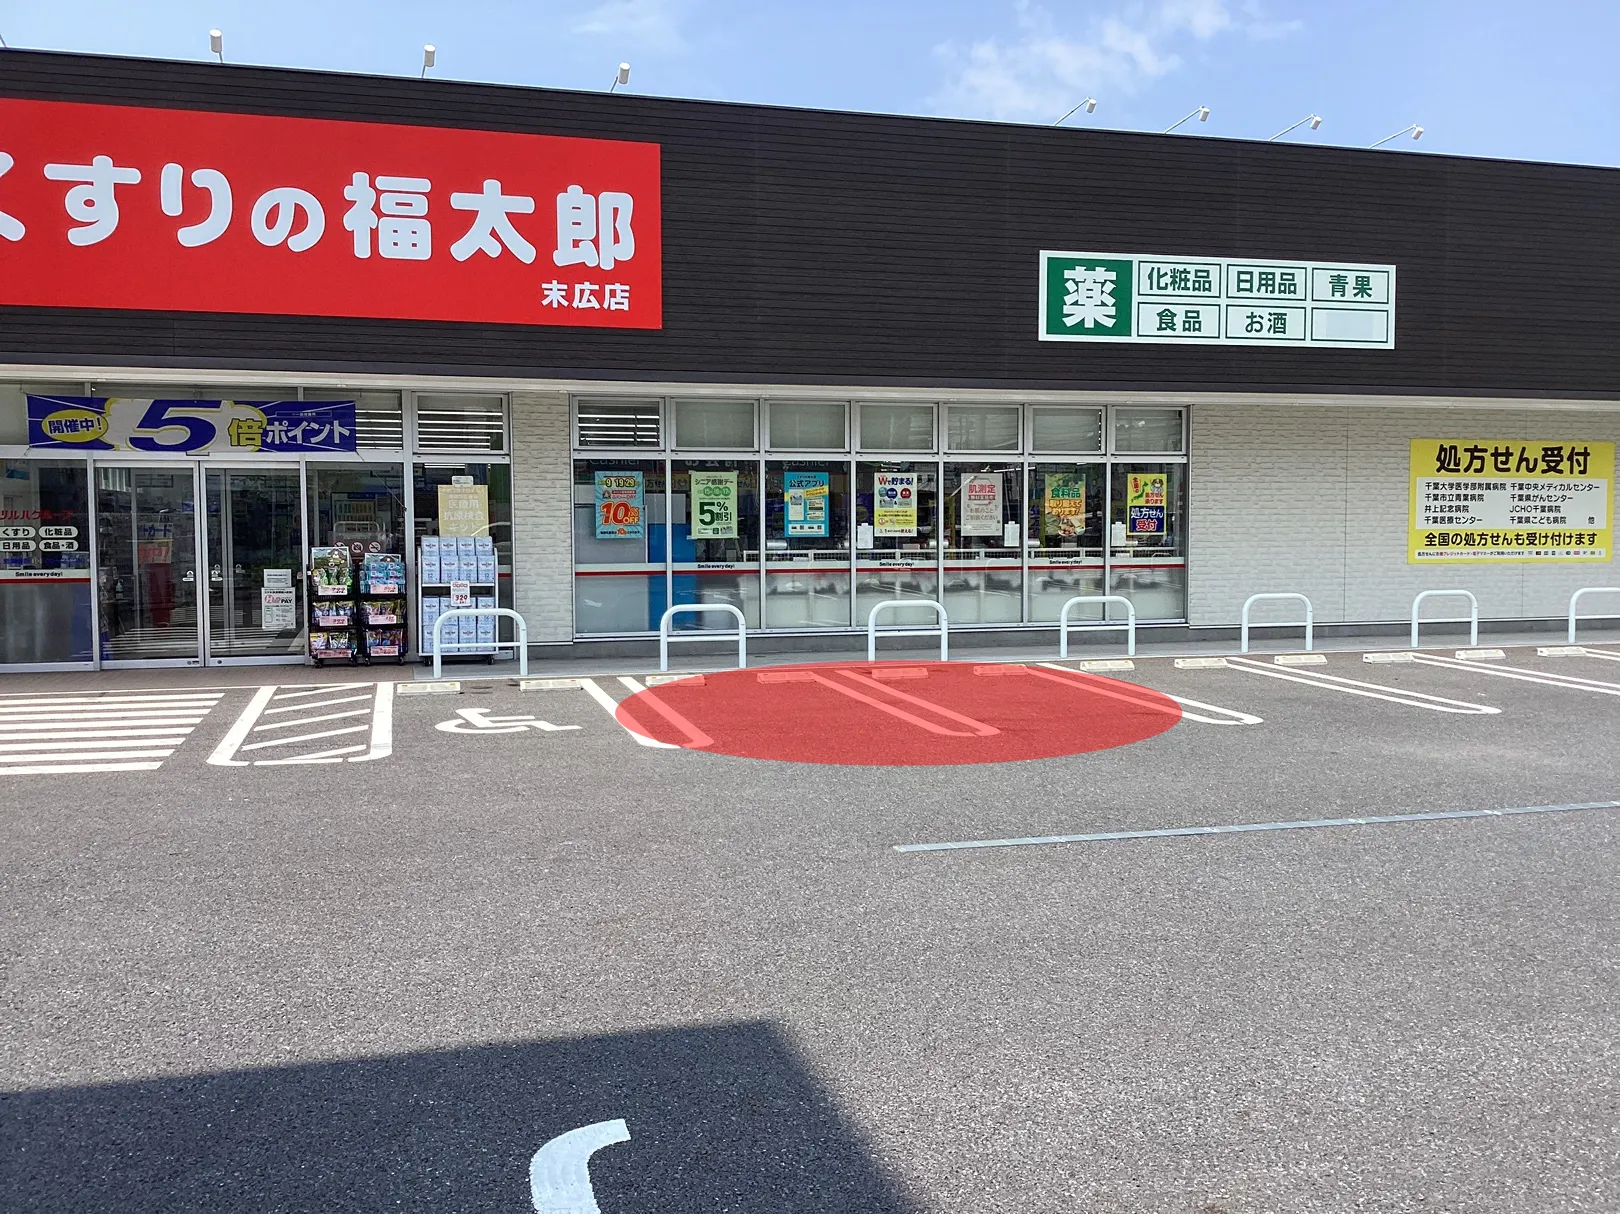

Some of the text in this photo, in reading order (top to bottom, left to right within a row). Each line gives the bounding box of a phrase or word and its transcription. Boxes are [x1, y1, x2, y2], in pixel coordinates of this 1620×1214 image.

[1147, 266, 1213, 292] 化粧品
[1235, 270, 1298, 295] 日用品
[1328, 274, 1374, 298] 青果
[540, 280, 632, 311] 末広店
[1062, 265, 1118, 328] 薬
[1156, 308, 1212, 333] 食品
[1244, 311, 1298, 335] お酒
[48, 417, 103, 436] 開催中!
[1435, 444, 1591, 474] 処方せん受付
[695, 478, 734, 486] シニア感謝デー
[789, 479, 824, 488] 公式アプリ
[1425, 482, 1600, 492] 千葉大学医学部附属病院 千葉中央メディカルセンター
[968, 485, 996, 494] 肌測定
[1051, 488, 1081, 498] 食料品
[1425, 493, 1573, 502] 千葉市立青葉病院 千葉県がんセンター
[448, 499, 479, 509] 医療用
[1424, 505, 1561, 513] 井上記念病院 JCHO千葉病院
[444, 511, 485, 521] 抗原検査
[715, 512, 732, 521] 割引
[1131, 508, 1163, 518] 処方せん
[1136, 519, 1157, 531] 受付
[1424, 516, 1595, 525] 千葉医療センター 千葉県こども病院 他
[3, 528, 30, 536] くすり
[45, 528, 72, 536] 化粧品
[448, 523, 480, 532] キット
[1424, 532, 1597, 547] 全国の処方せんも受け付けます
[3, 542, 30, 550] 日用品
[44, 541, 74, 550] 食品・酒
